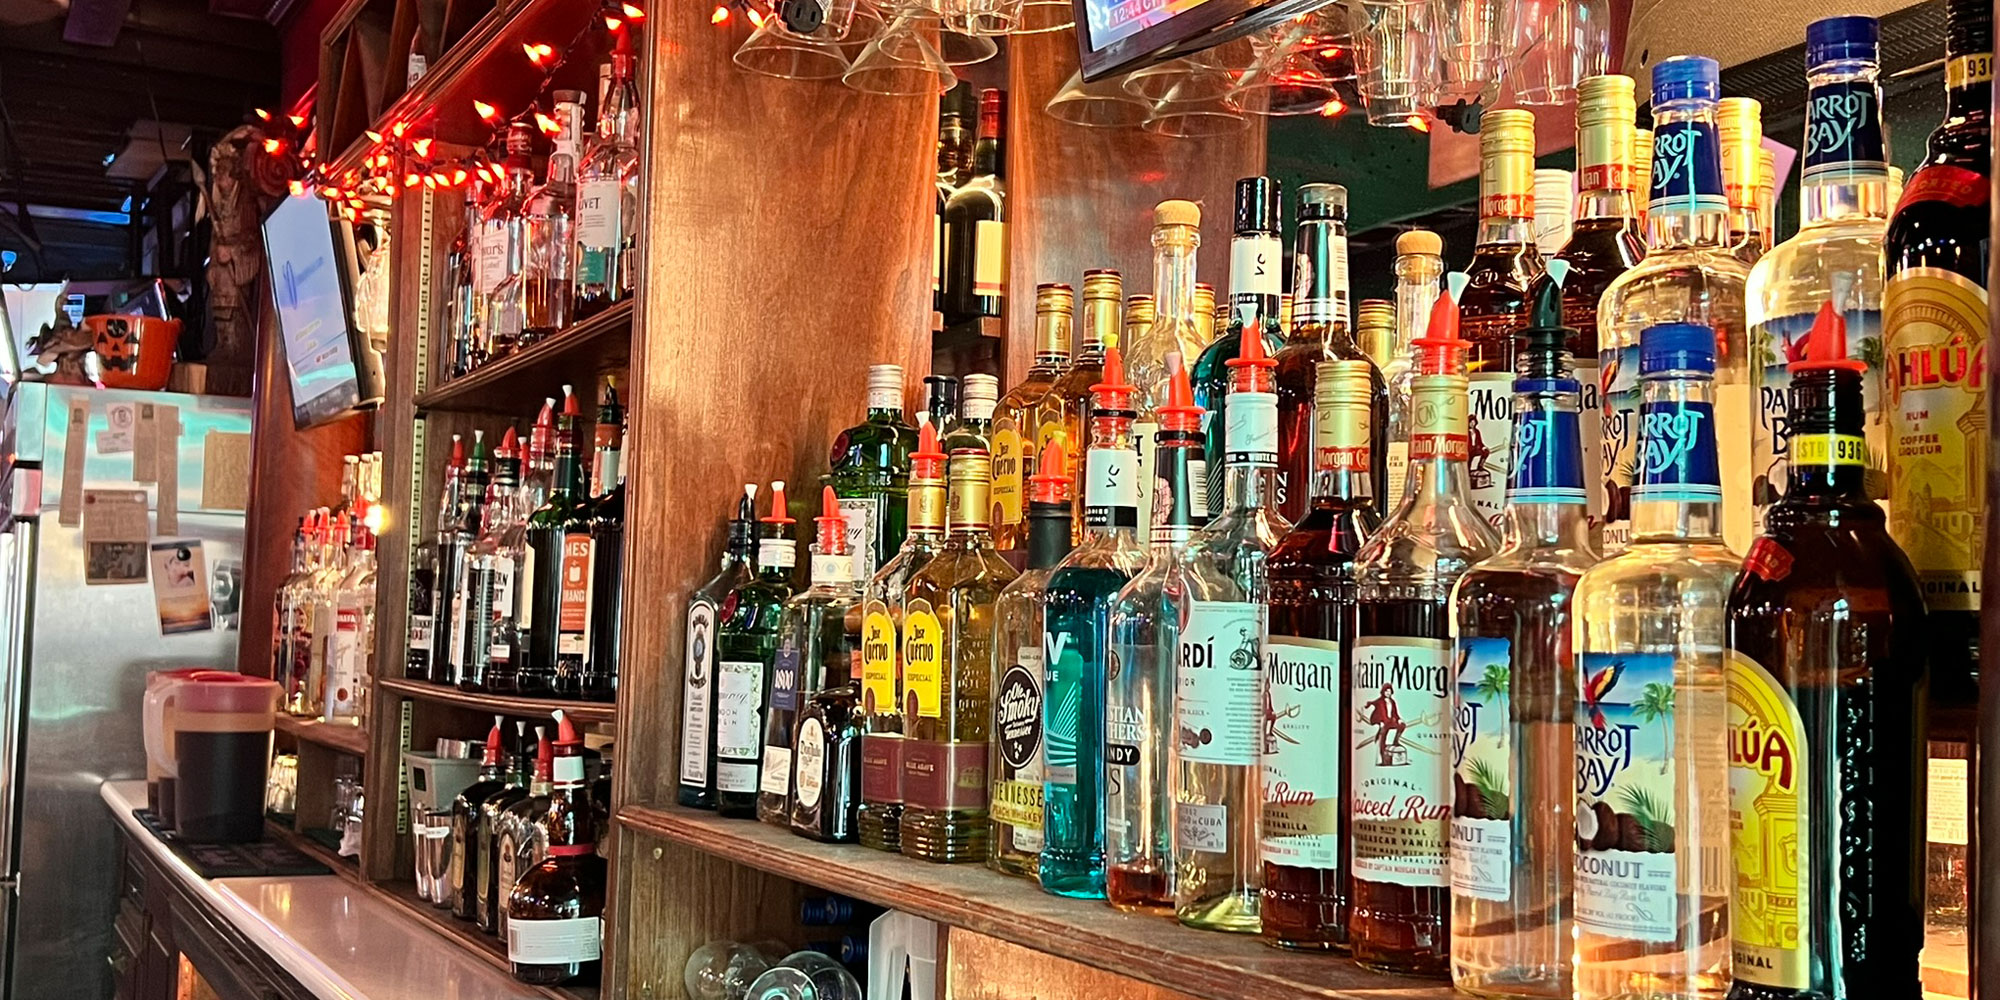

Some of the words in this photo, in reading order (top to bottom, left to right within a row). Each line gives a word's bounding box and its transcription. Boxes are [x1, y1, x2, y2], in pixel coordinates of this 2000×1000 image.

[1806, 90, 1872, 129] ARROT
[1654, 130, 1702, 167] RROT
[1652, 155, 1684, 189] AY
[1470, 389, 1513, 420] Mor
[1906, 410, 1928, 420] RUM
[1602, 409, 1634, 450] RROT
[1640, 409, 1704, 451] ARROT
[1900, 434, 1938, 445] COFFEE
[1431, 435, 1467, 457] Morga
[1602, 439, 1621, 476] AY
[1898, 445, 1942, 456] LIQUEUR
[864, 636, 888, 665] Cuervo
[906, 635, 934, 666] Cuervo
[1044, 671, 1059, 682] UE
[1266, 652, 1331, 693] Morgan
[1353, 655, 1384, 689] tain
[1386, 655, 1448, 699] Morg
[1000, 689, 1040, 724] Smoky
[1108, 706, 1147, 723] STIAN
[1107, 723, 1147, 741] HERS
[1452, 702, 1483, 744] ROT
[1108, 748, 1133, 763] NDY
[1574, 723, 1640, 771] ARROT
[1728, 719, 1792, 790] LÚA
[1576, 754, 1620, 797] BAY
[994, 782, 1043, 808] TENNESSE
[1272, 781, 1316, 808] Rum
[1352, 794, 1396, 817] piced
[1198, 815, 1222, 827] CUBA
[1401, 827, 1427, 836] REAL
[1451, 823, 1484, 843] ONUT
[1401, 839, 1450, 849] VANILLA
[1575, 854, 1643, 879] OCONUT
[1736, 951, 1773, 969] GINAL
